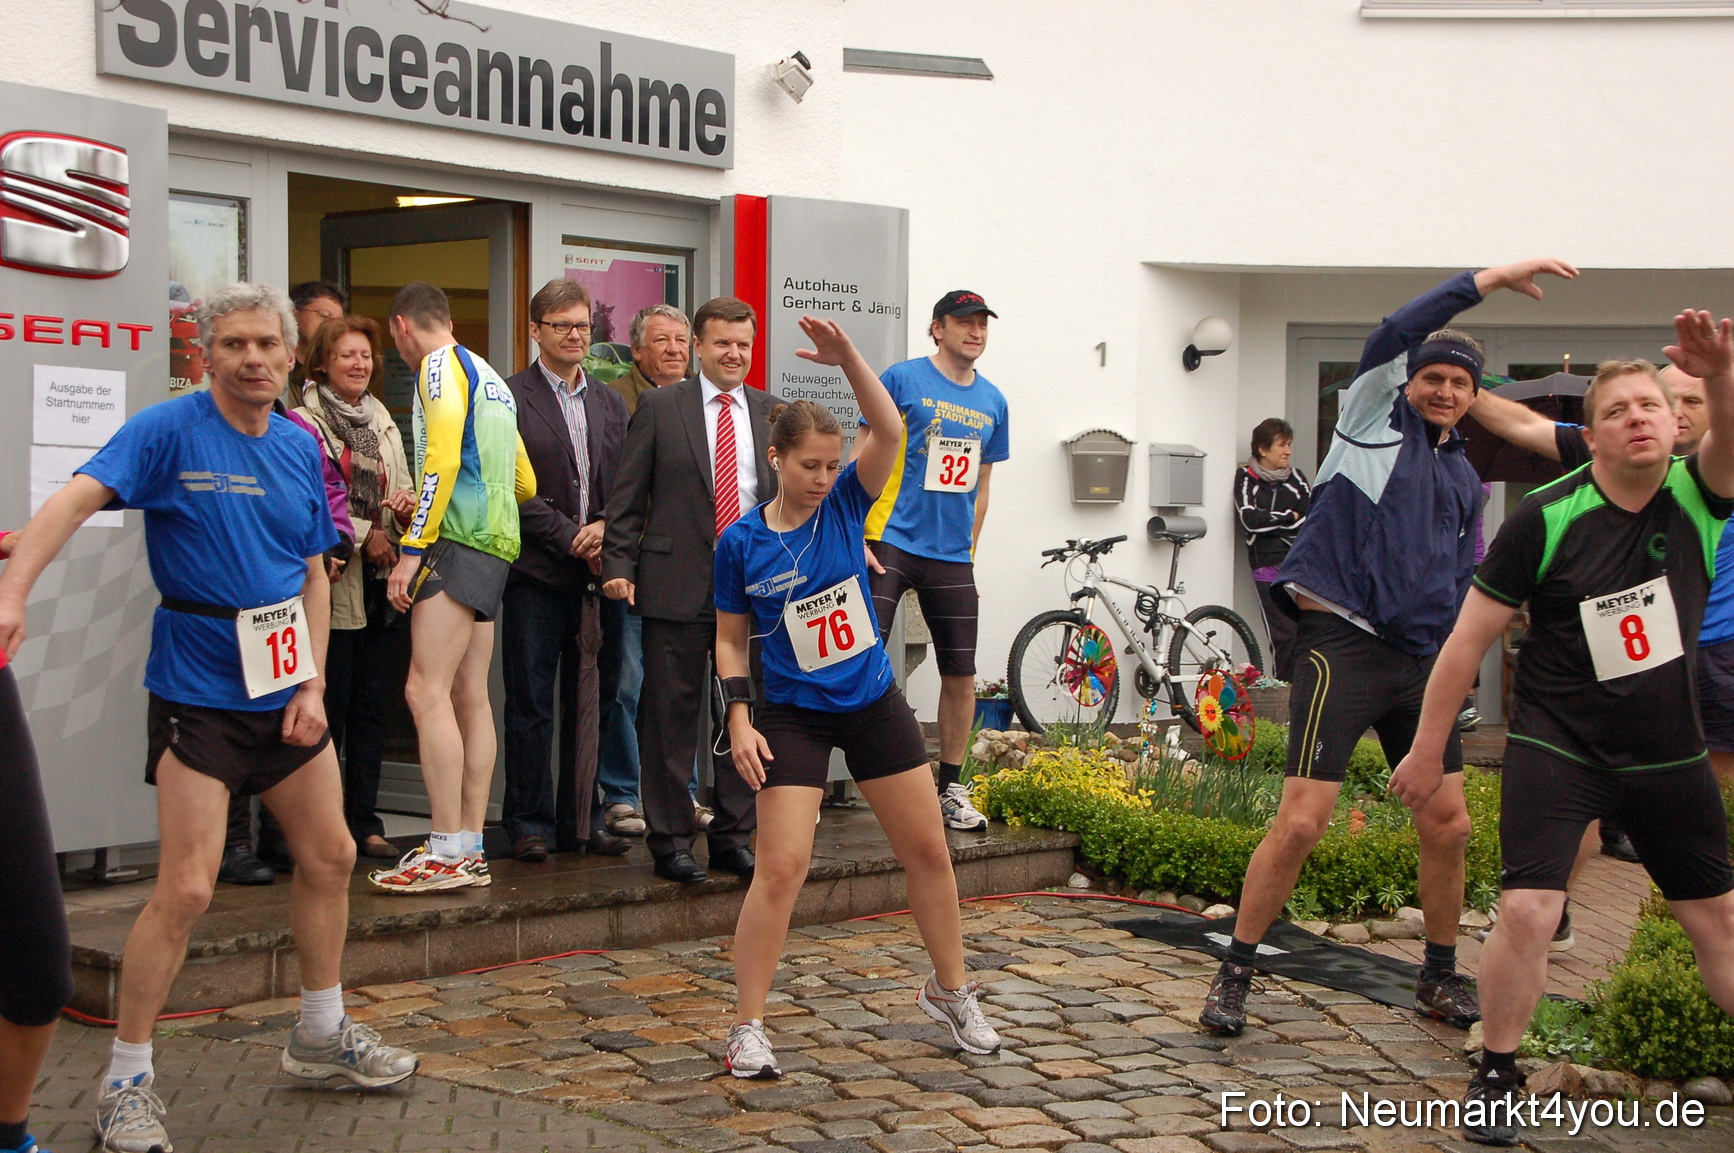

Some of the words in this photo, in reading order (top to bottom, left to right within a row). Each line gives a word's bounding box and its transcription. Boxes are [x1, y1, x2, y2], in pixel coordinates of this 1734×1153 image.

[117, 0, 727, 157] Serviceannahme
[575, 257, 606, 265] SEAT
[783, 277, 858, 294] Autohaus
[783, 296, 845, 311] Gerhart
[852, 300, 862, 313] &
[868, 301, 901, 319] Jänig
[1095, 341, 1107, 367] 1
[50, 381, 93, 396] Ausgabe
[96, 384, 112, 396] der
[782, 372, 841, 388] Neuwagen
[782, 387, 857, 400] Gebrauchtwa
[46, 396, 115, 411] Startnummern
[828, 406, 854, 417] rung
[921, 398, 936, 408] 10.
[937, 400, 993, 426] NEUMARKTER
[72, 413, 91, 424] hier
[934, 409, 984, 430] STADTLAUF
[939, 440, 963, 448] MEYER
[939, 454, 969, 487] 32
[408, 472, 440, 540] BOCK
[795, 592, 832, 614] MEYER
[1596, 592, 1638, 612] MEYER
[1597, 602, 1641, 618] WERBUNG
[252, 607, 288, 625] MEYER
[798, 603, 835, 620] WERBUNG
[253, 617, 290, 632] WERBUNG
[806, 609, 855, 659] 76
[1619, 614, 1651, 661] 8
[266, 627, 298, 680] 13
